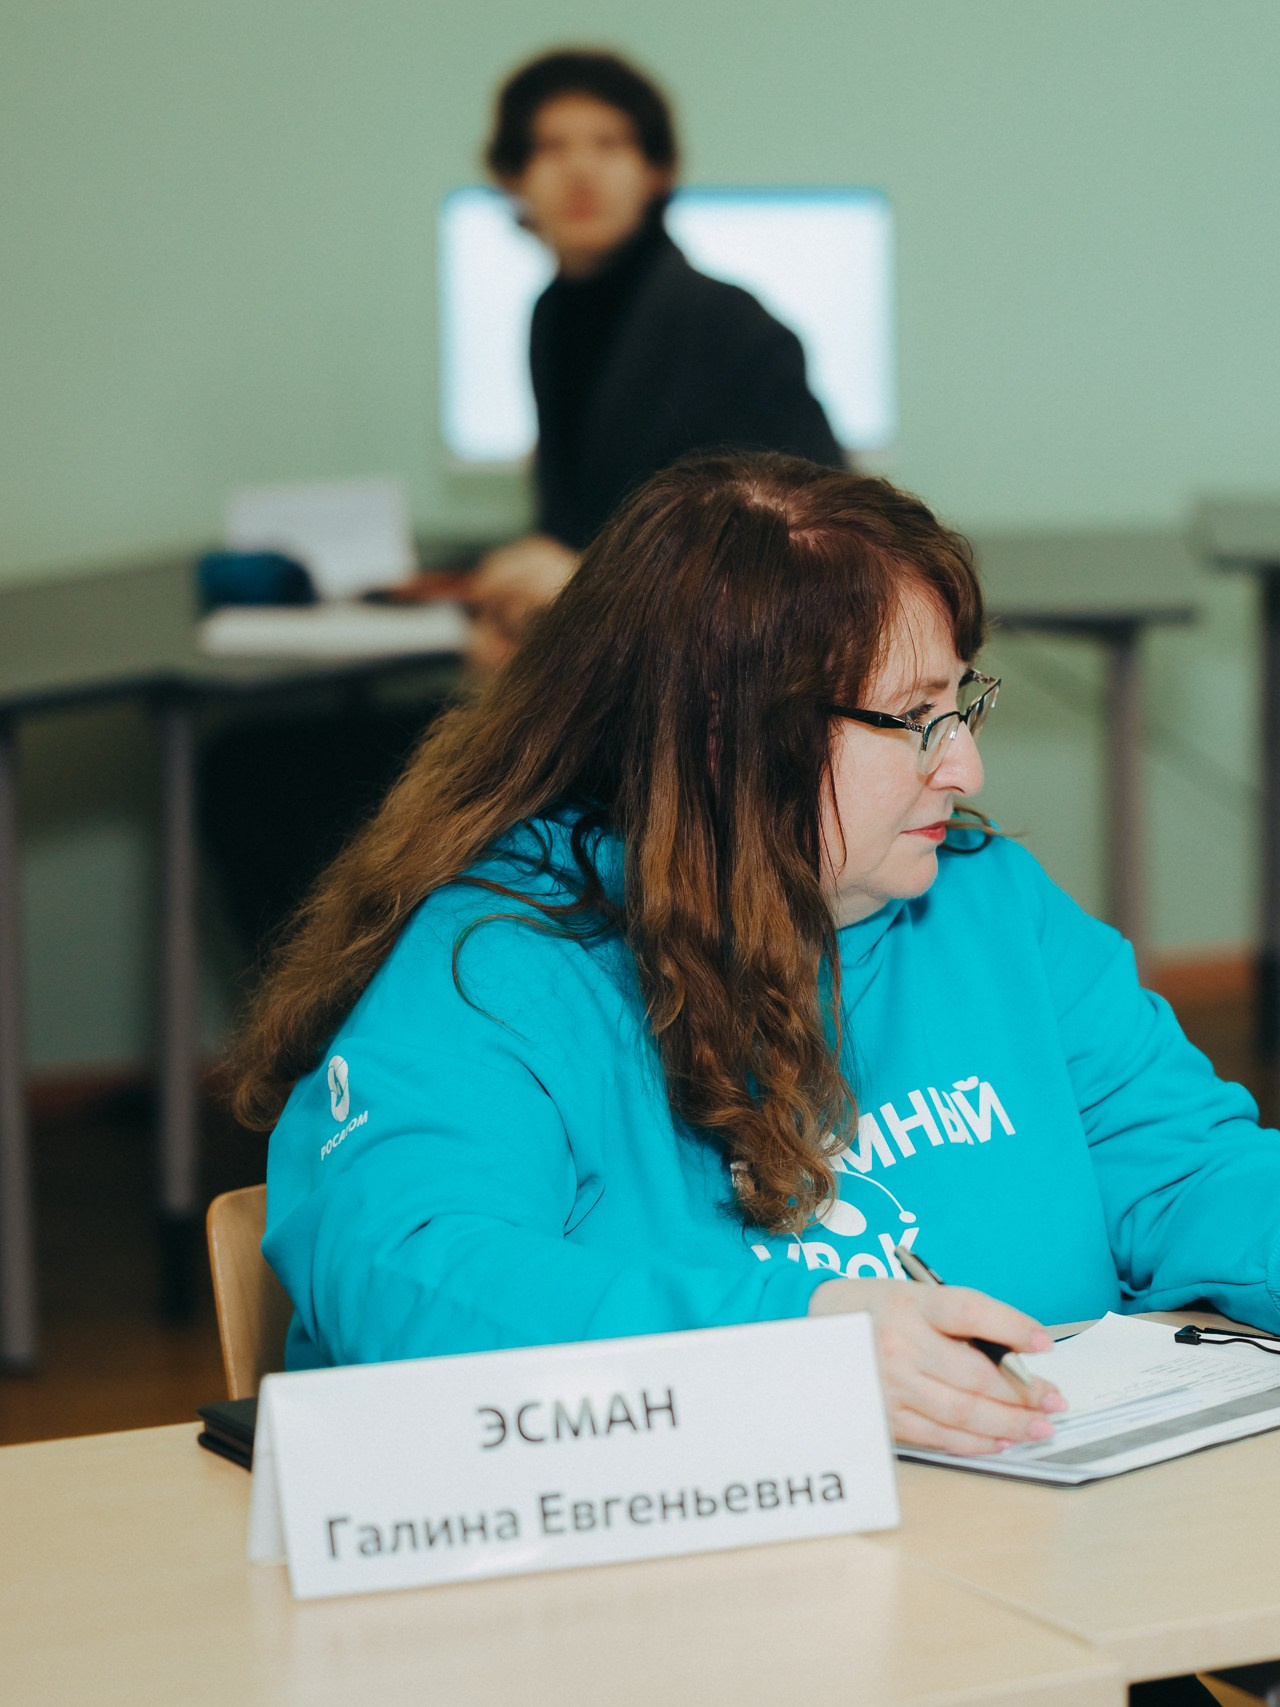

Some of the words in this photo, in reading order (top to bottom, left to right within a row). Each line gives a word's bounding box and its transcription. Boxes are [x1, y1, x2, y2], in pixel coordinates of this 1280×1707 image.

[320, 1110, 369, 1161] РОСАТОМ
[816, 1075, 1017, 1175] МНЫЙ
[476, 1387, 679, 1449] ЭСМАН
[326, 1508, 520, 1559] Галина
[538, 1471, 847, 1537] Евгеньевна
